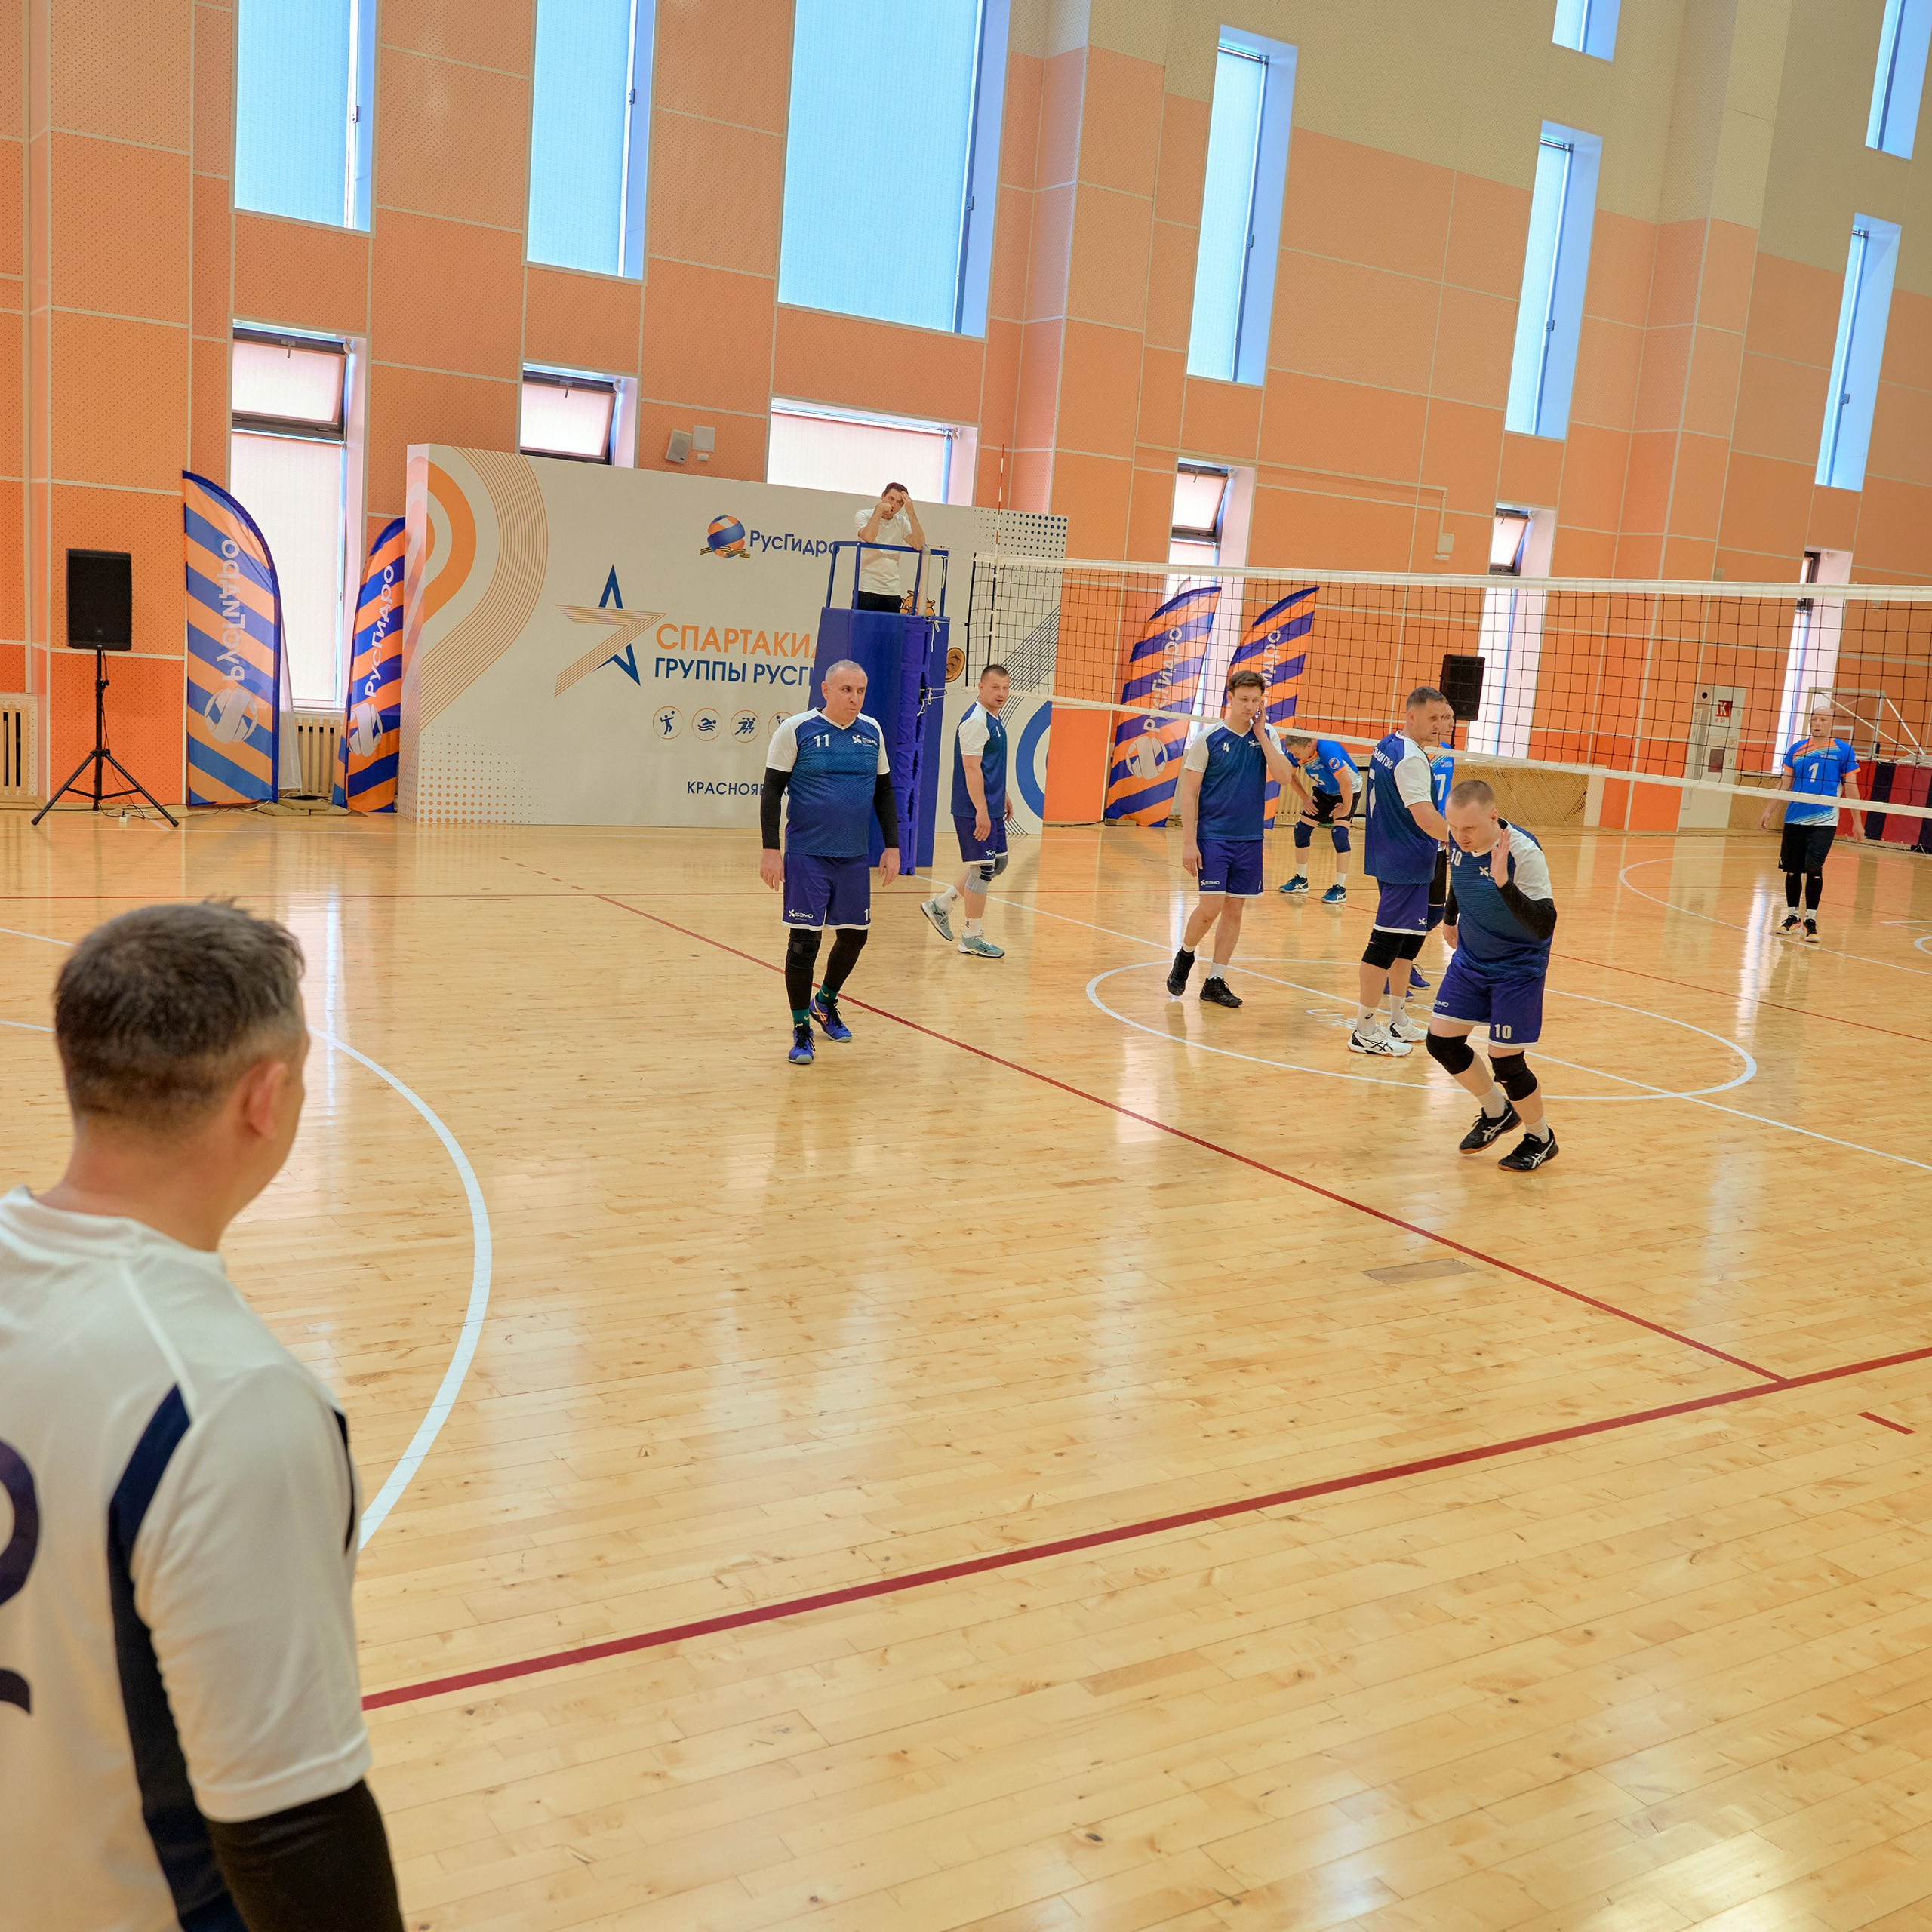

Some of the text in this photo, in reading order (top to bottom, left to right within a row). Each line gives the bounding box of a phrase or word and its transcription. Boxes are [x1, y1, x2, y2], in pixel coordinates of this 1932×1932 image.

[656, 623, 816, 659] СПАРТАКИ
[654, 657, 814, 687] ГРУППЫ РУСГ
[814, 734, 829, 748] 11
[1223, 742, 1230, 752] 4
[1808, 763, 1819, 783] 1
[687, 781, 764, 796] КРАСНОЯ
[1435, 774, 1446, 801] 7
[1451, 848, 1463, 866] 10
[1494, 1023, 1512, 1040] 10
